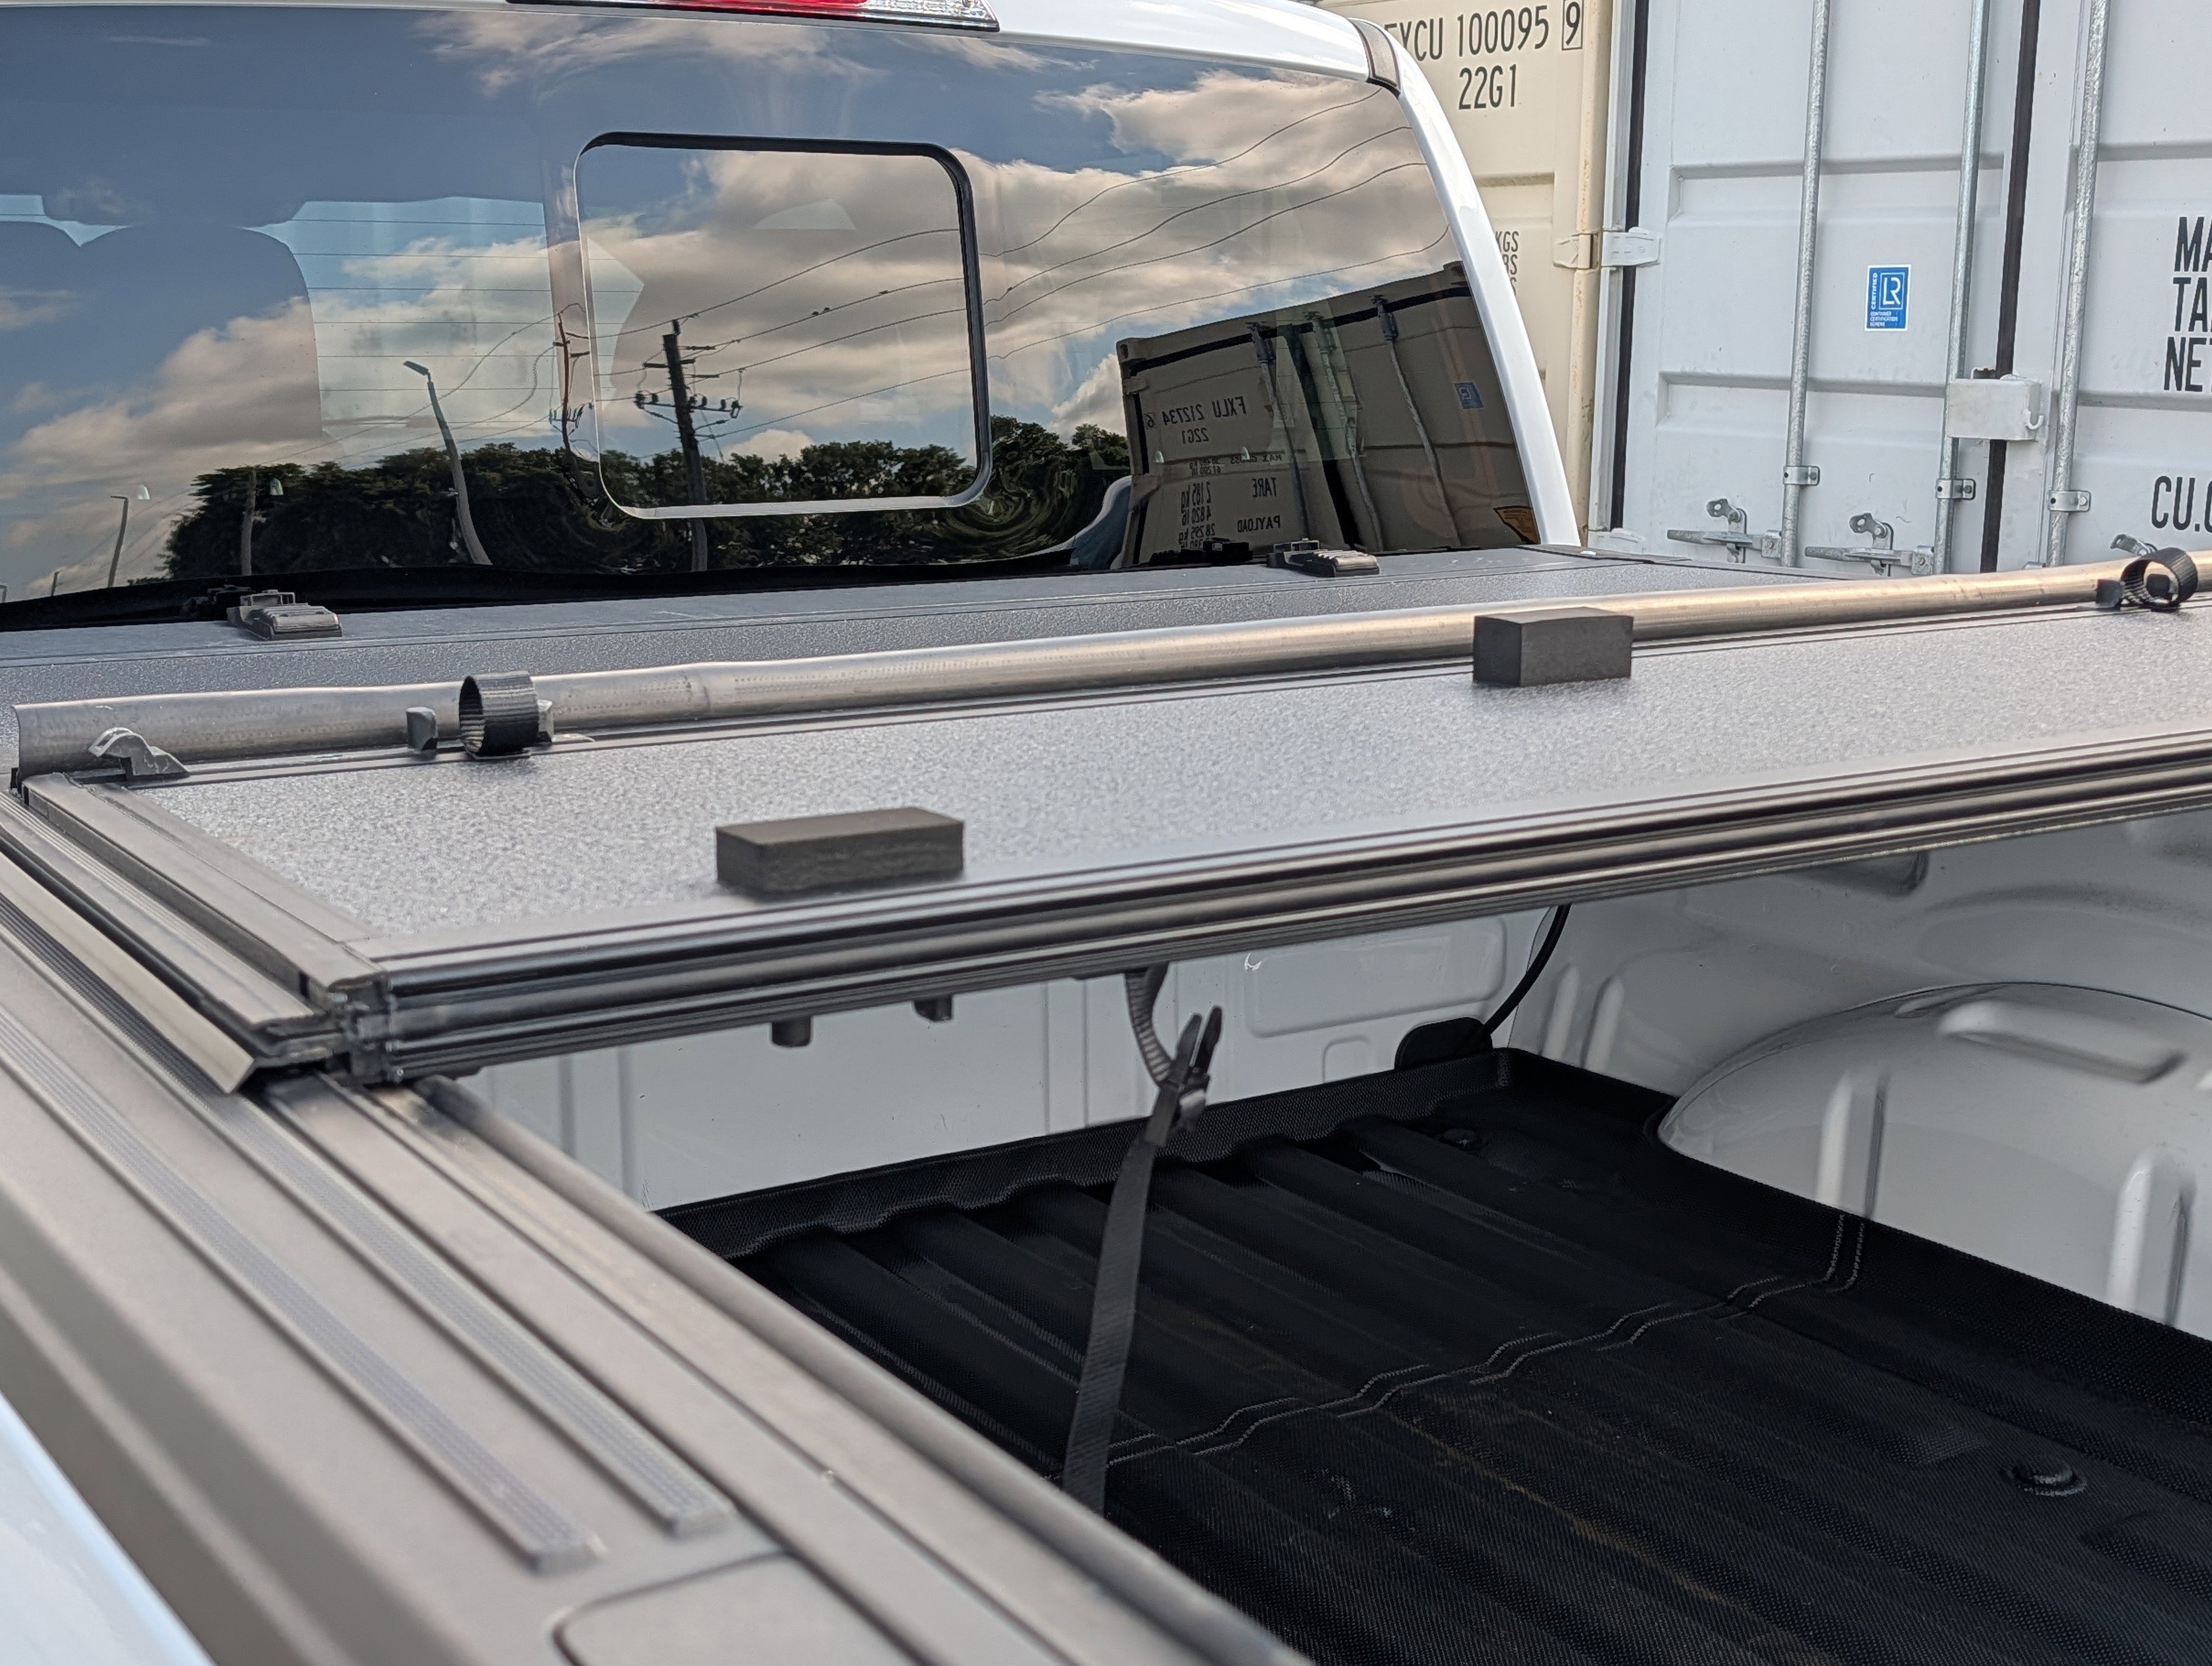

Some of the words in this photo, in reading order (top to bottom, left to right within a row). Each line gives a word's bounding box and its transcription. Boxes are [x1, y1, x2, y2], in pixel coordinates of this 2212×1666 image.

[1457, 5, 1549, 57] 100095
[1566, 2, 1581, 46] 9
[1459, 64, 1516, 110] 22G1
[1883, 277, 1901, 305] LR
